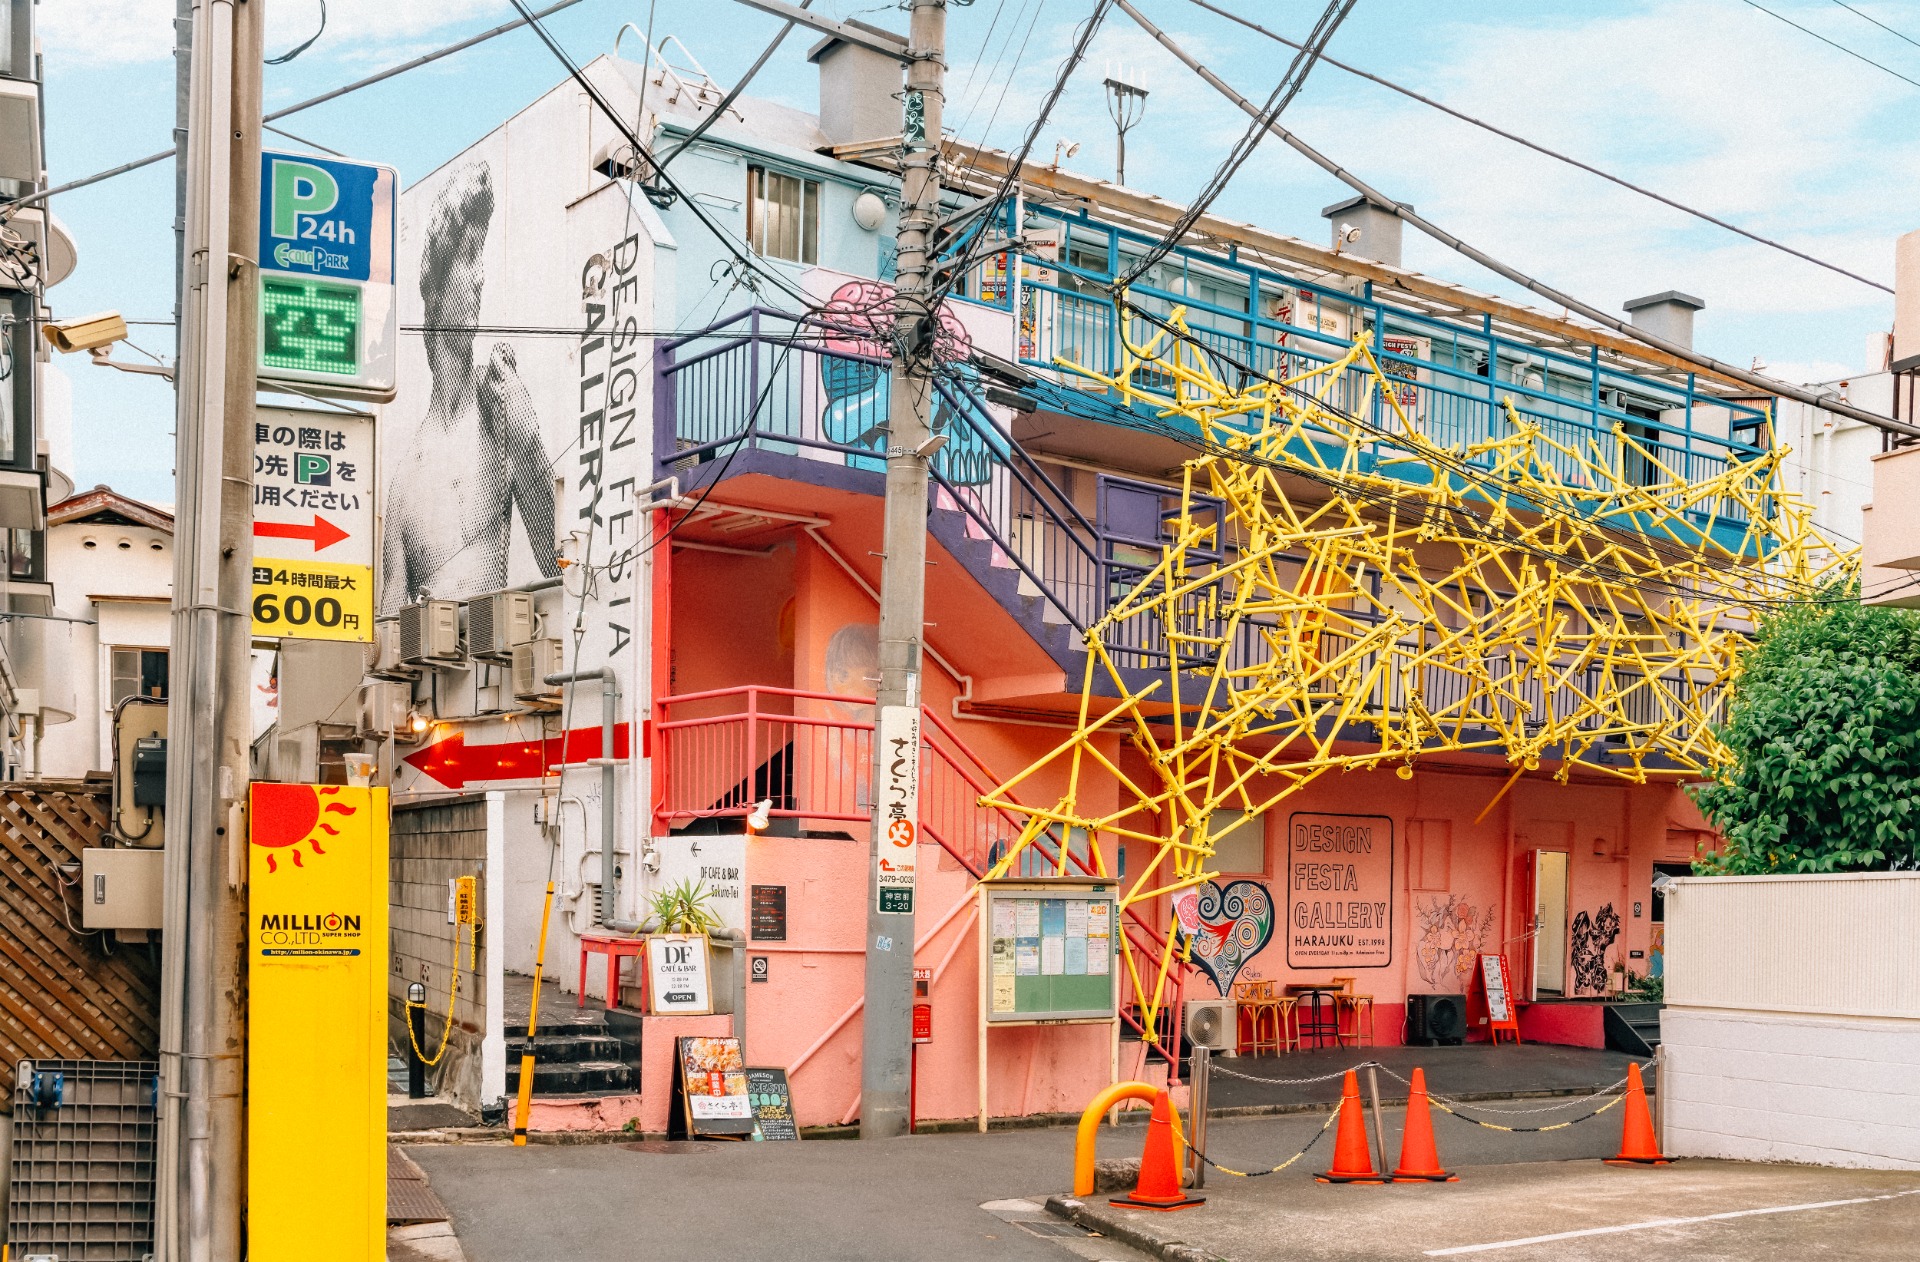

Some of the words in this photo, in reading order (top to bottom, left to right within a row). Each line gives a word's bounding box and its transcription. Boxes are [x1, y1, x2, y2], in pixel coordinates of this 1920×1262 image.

[271, 159, 339, 240] P
[301, 217, 356, 245] 24h
[264, 285, 356, 375] 空
[610, 233, 638, 452] DESIGN
[579, 253, 605, 528] GALLERY
[255, 484, 359, 511] 用ください
[888, 737, 909, 823] さくら亭
[1295, 824, 1371, 853] DESIGN
[701, 866, 707, 878] DF
[709, 866, 720, 880] CAFE
[722, 868, 726, 880] &
[728, 867, 739, 880] BAR
[1294, 863, 1358, 891] FESTA
[885, 892, 909, 900] 神宮前
[885, 902, 909, 910] 3-20
[261, 913, 361, 931] MILLION
[1294, 902, 1386, 929] GALLERY
[664, 946, 692, 963] DF
[1295, 935, 1354, 947] HARAJUKU
[748, 1083, 787, 1095] AMESON
